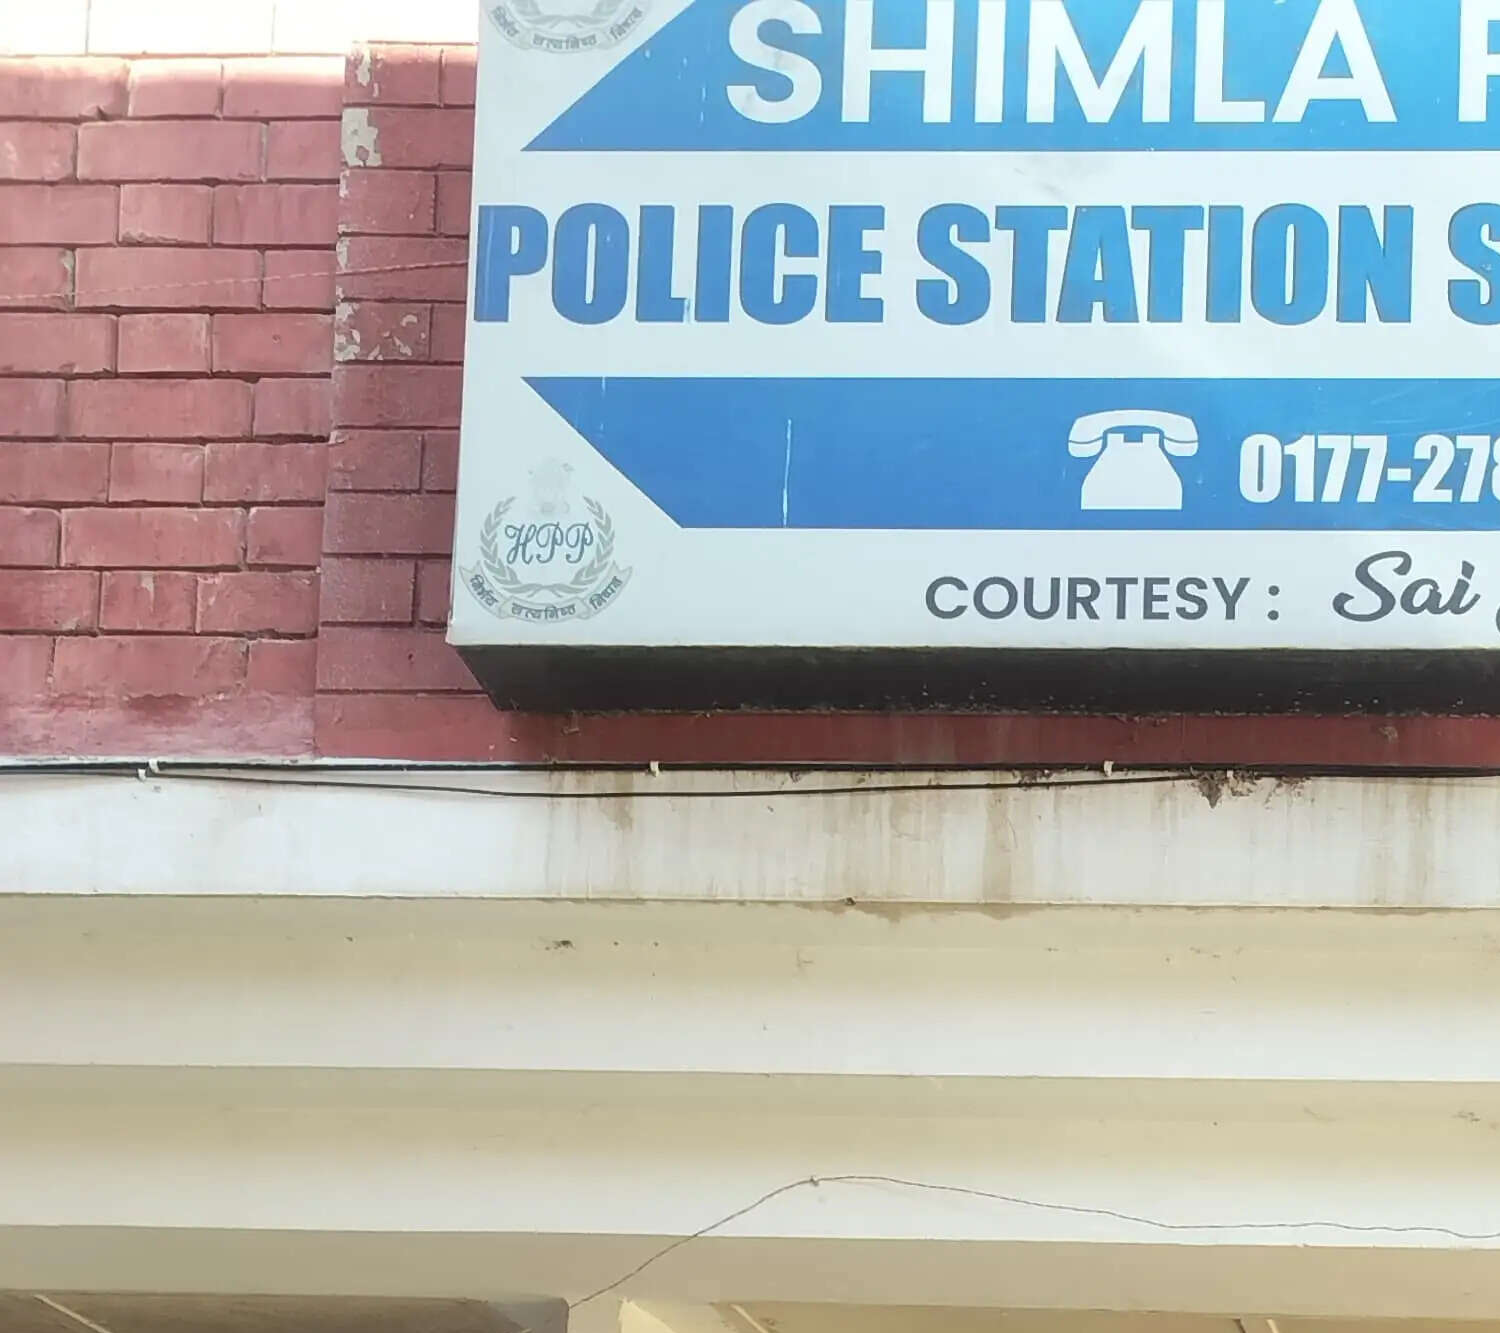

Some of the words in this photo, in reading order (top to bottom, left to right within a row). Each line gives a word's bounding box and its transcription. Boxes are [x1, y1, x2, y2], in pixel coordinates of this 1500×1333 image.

[726, 0, 1396, 123] SHIMLA
[475, 203, 885, 324] POLICE
[916, 203, 1414, 325] STATION
[1332, 550, 1481, 622] Sai
